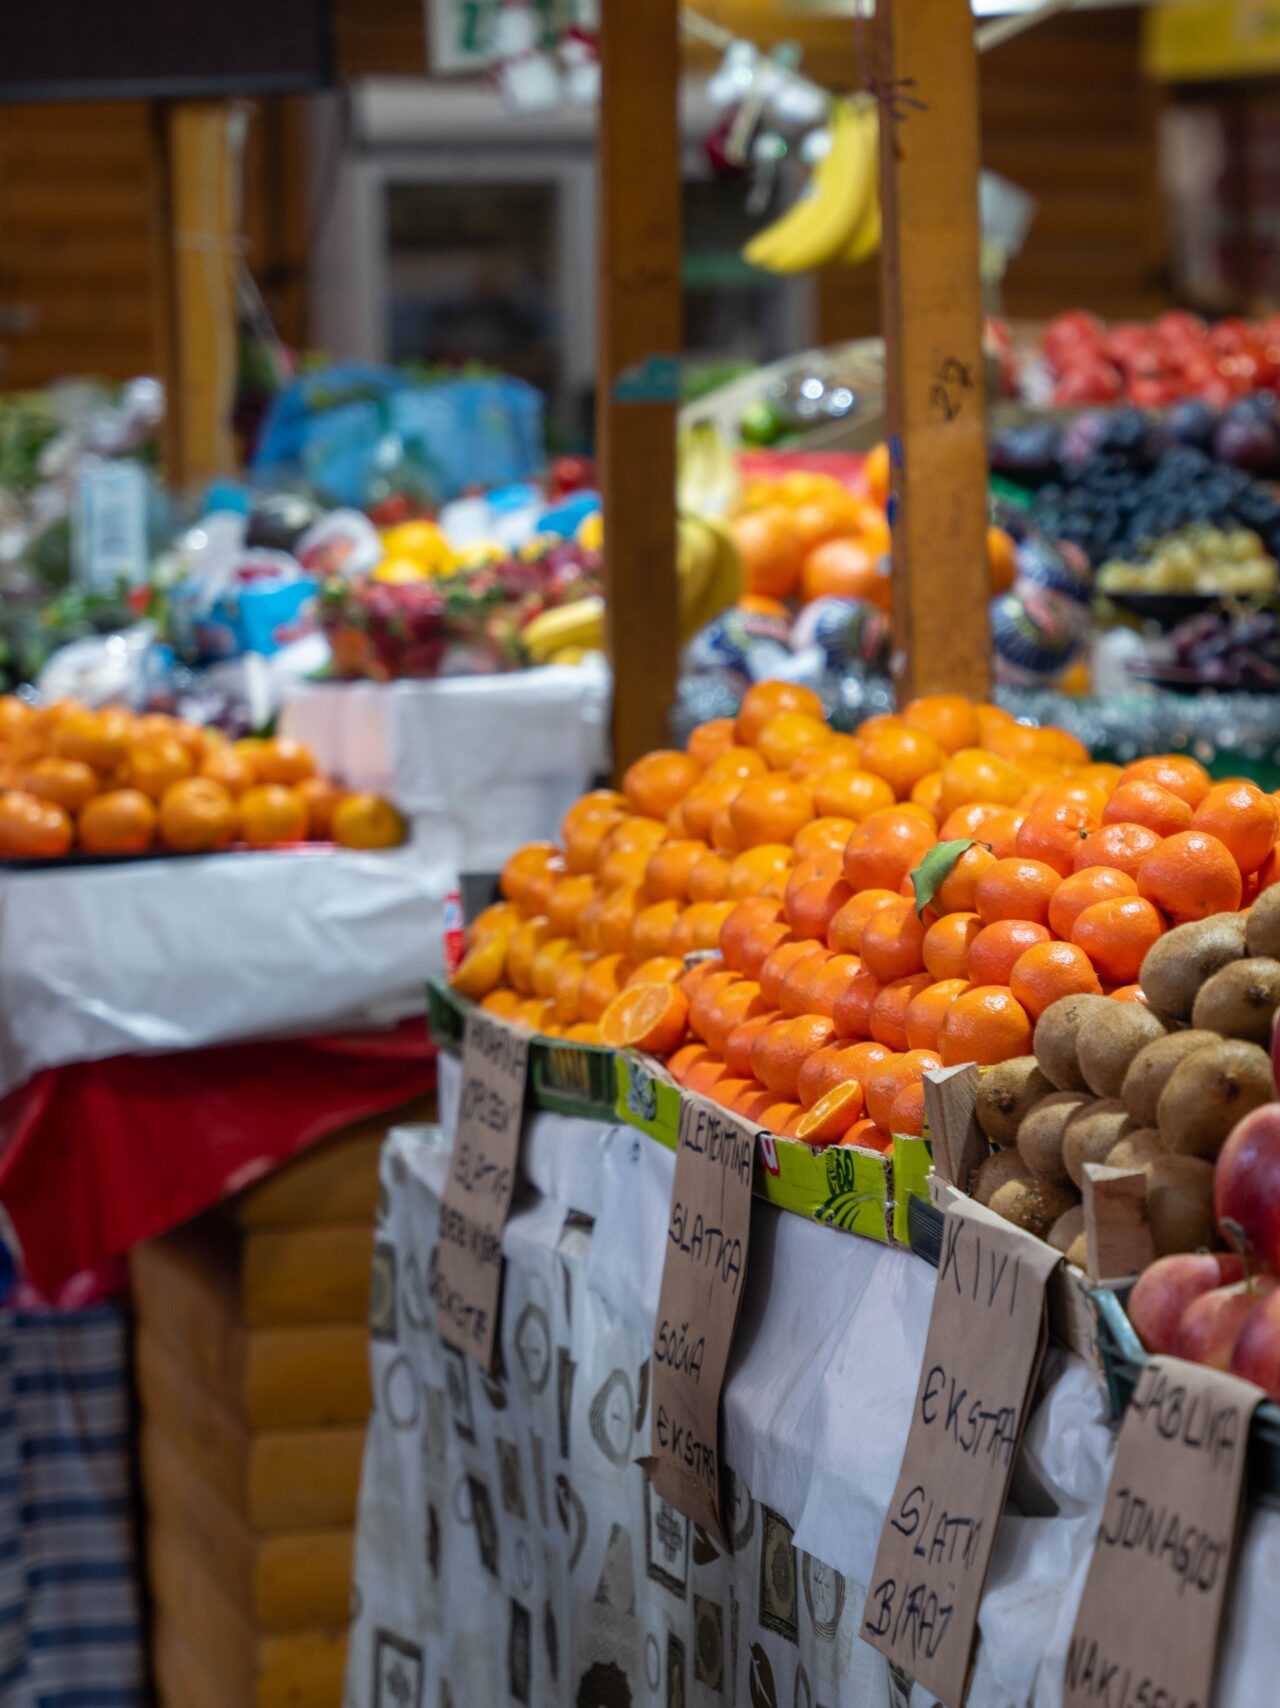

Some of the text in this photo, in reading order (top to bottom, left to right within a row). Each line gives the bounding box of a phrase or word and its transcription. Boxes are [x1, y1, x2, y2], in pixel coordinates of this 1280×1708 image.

[668, 1202, 742, 1294] SLATKA
[941, 1219, 1022, 1315] KIVI
[921, 1364, 1018, 1471] EKSTRA
